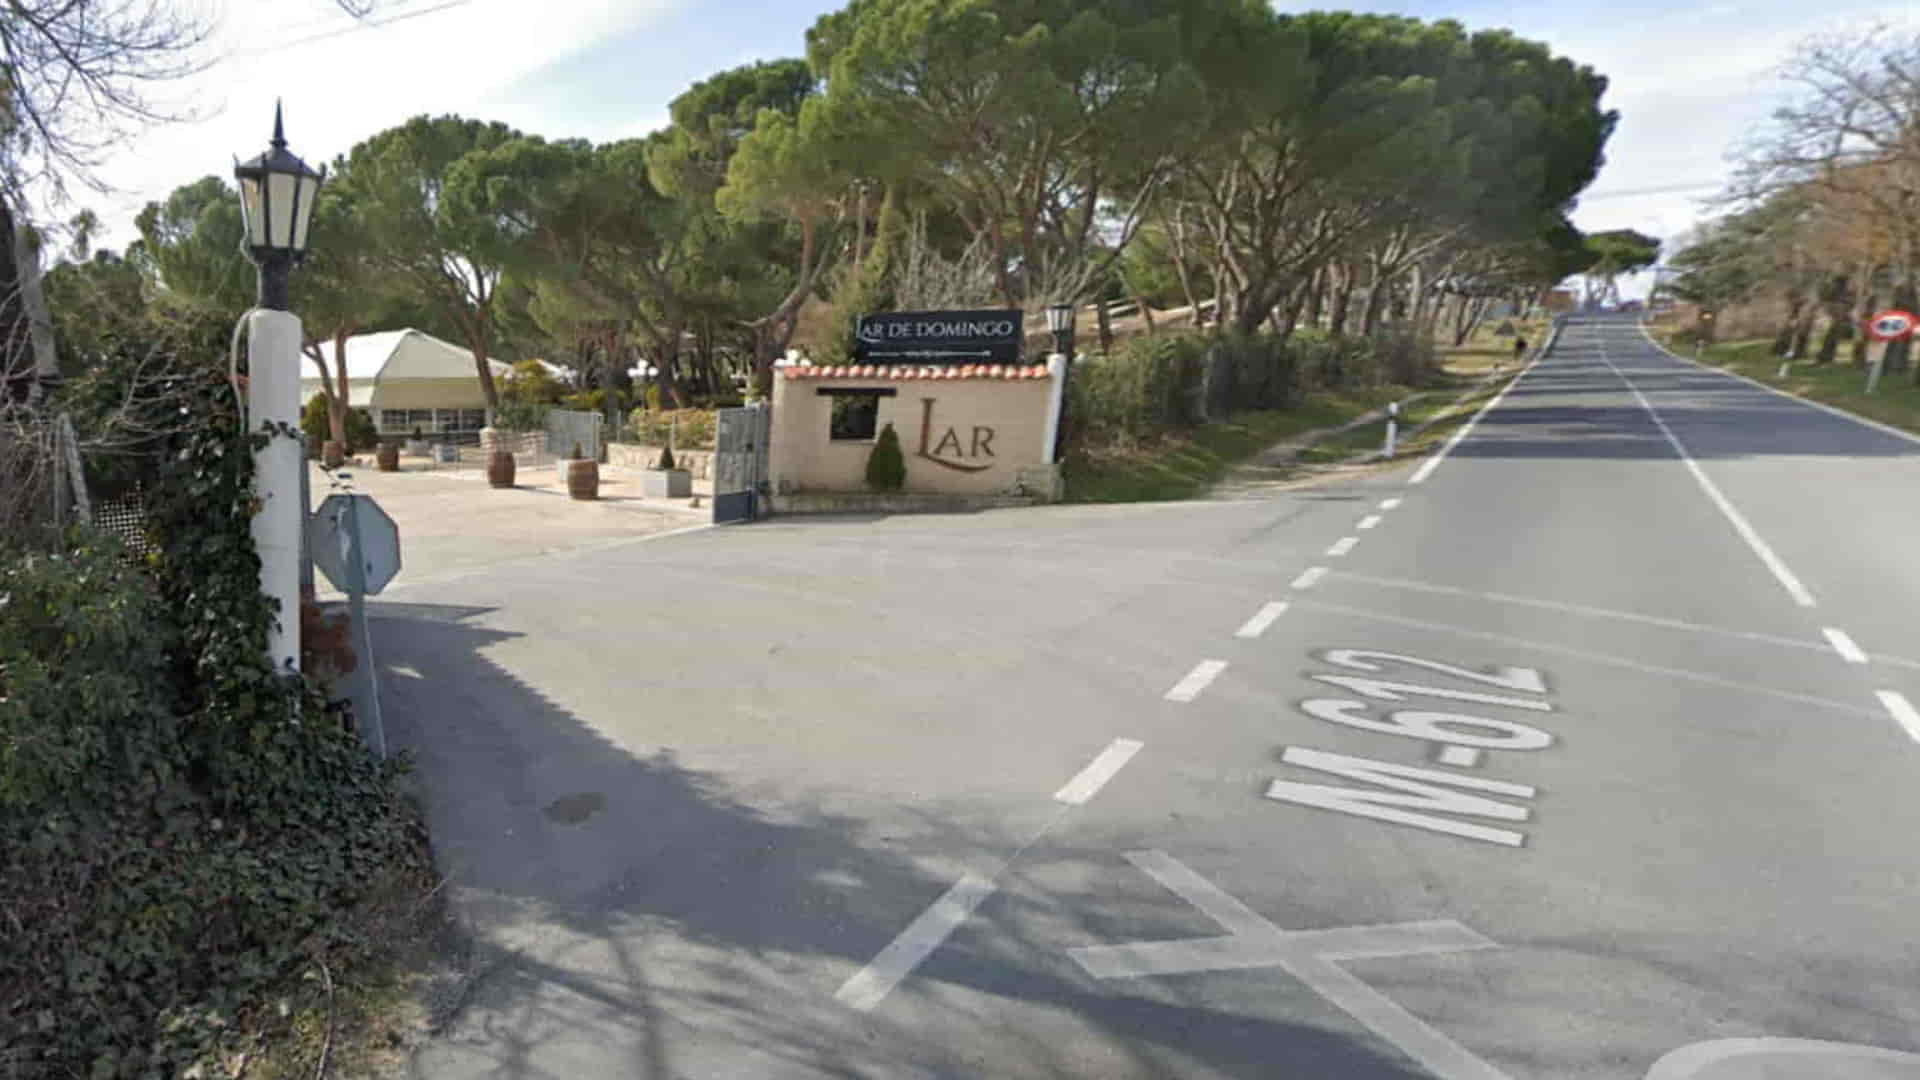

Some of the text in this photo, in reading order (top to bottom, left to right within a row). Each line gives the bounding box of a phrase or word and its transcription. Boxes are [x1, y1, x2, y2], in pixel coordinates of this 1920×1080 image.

[888, 321, 913, 338] DE
[917, 320, 1014, 338] DOMINGO
[913, 397, 995, 473] LAR
